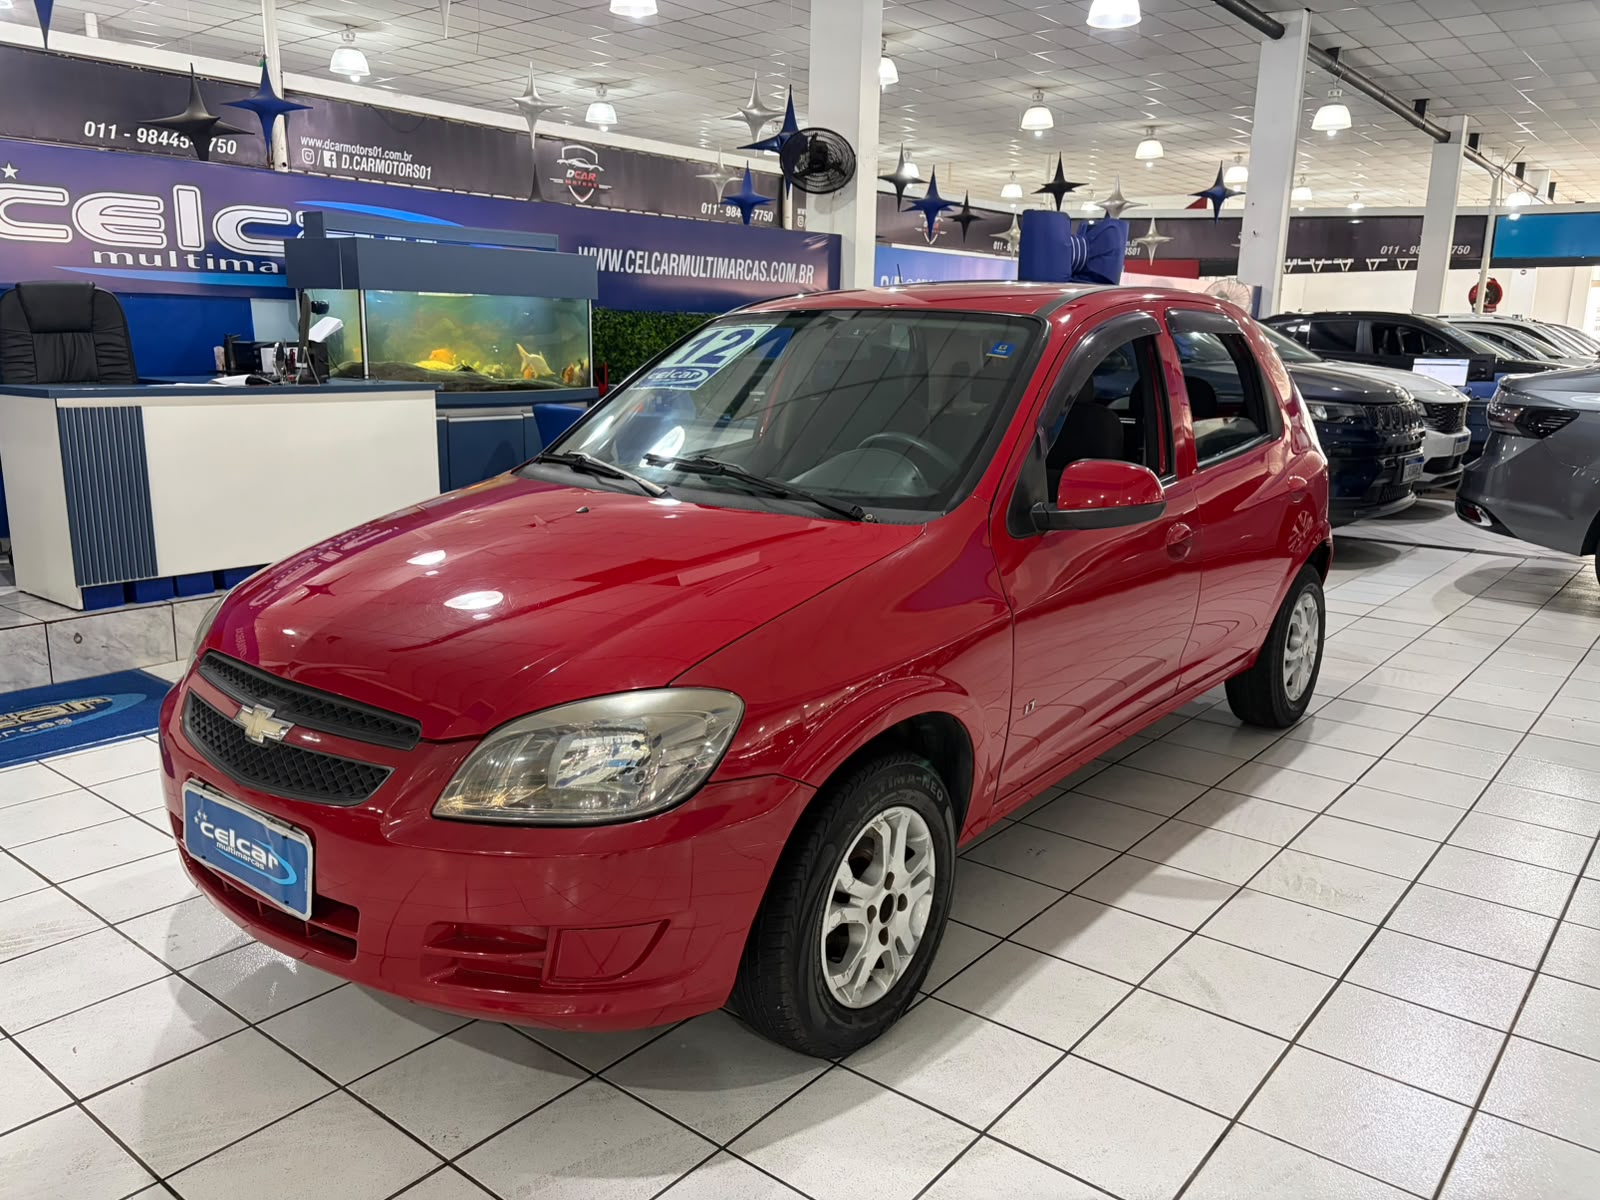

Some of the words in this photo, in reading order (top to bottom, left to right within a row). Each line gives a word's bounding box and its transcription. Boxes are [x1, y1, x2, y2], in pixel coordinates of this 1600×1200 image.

[84, 121, 117, 140] 011
[300, 136, 413, 162] www.dcarmotors01.com.br
[341, 153, 432, 181] D.CARMOTORS01
[566, 169, 597, 181] DCAR
[701, 202, 718, 216] 011
[1380, 245, 1400, 255] 011
[674, 328, 755, 365] 12
[200, 821, 279, 870] celcar
[215, 841, 265, 870] multimarcas
